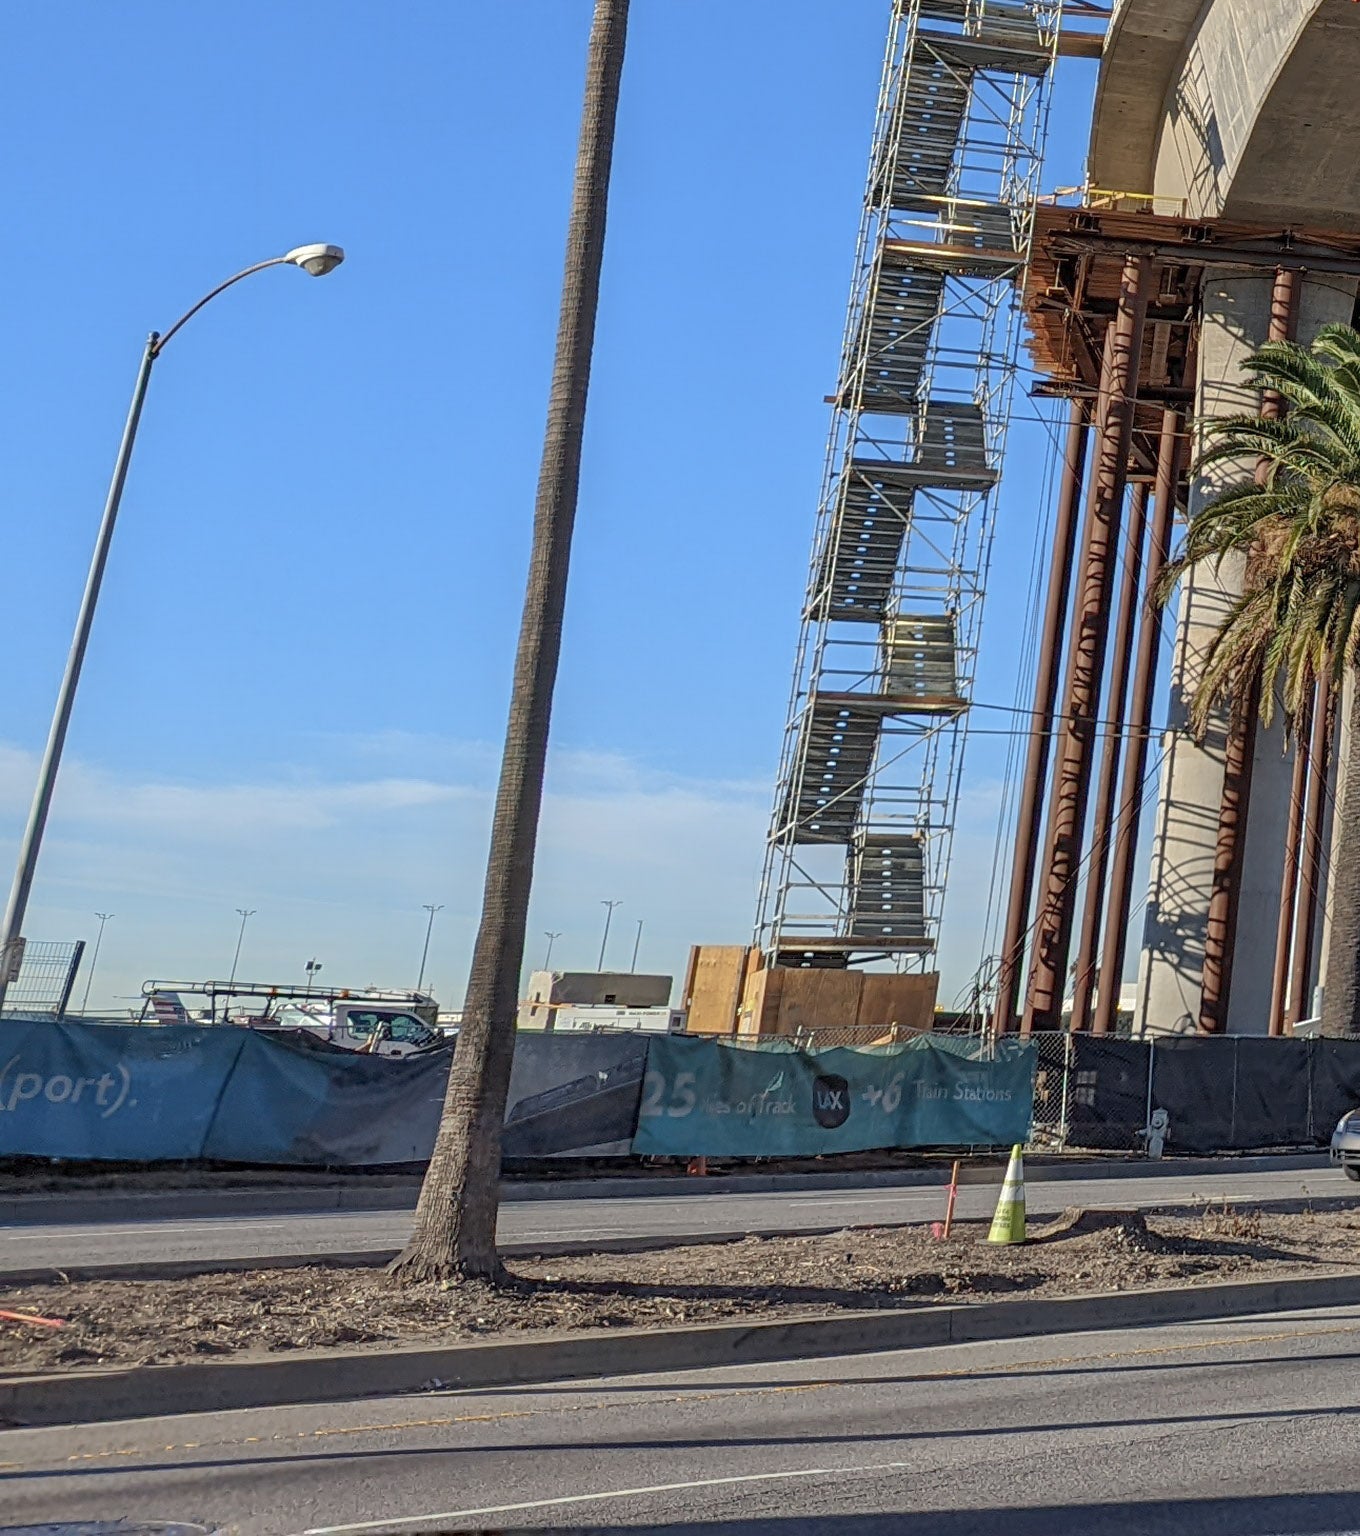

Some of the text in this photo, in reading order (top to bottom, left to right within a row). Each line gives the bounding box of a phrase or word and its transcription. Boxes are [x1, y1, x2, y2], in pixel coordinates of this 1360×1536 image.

[640, 1071, 697, 1117] 25
[758, 1094, 797, 1114] Track
[816, 1090, 844, 1111] LAX
[913, 1079, 948, 1101] Train
[952, 1080, 1013, 1103] Stations
